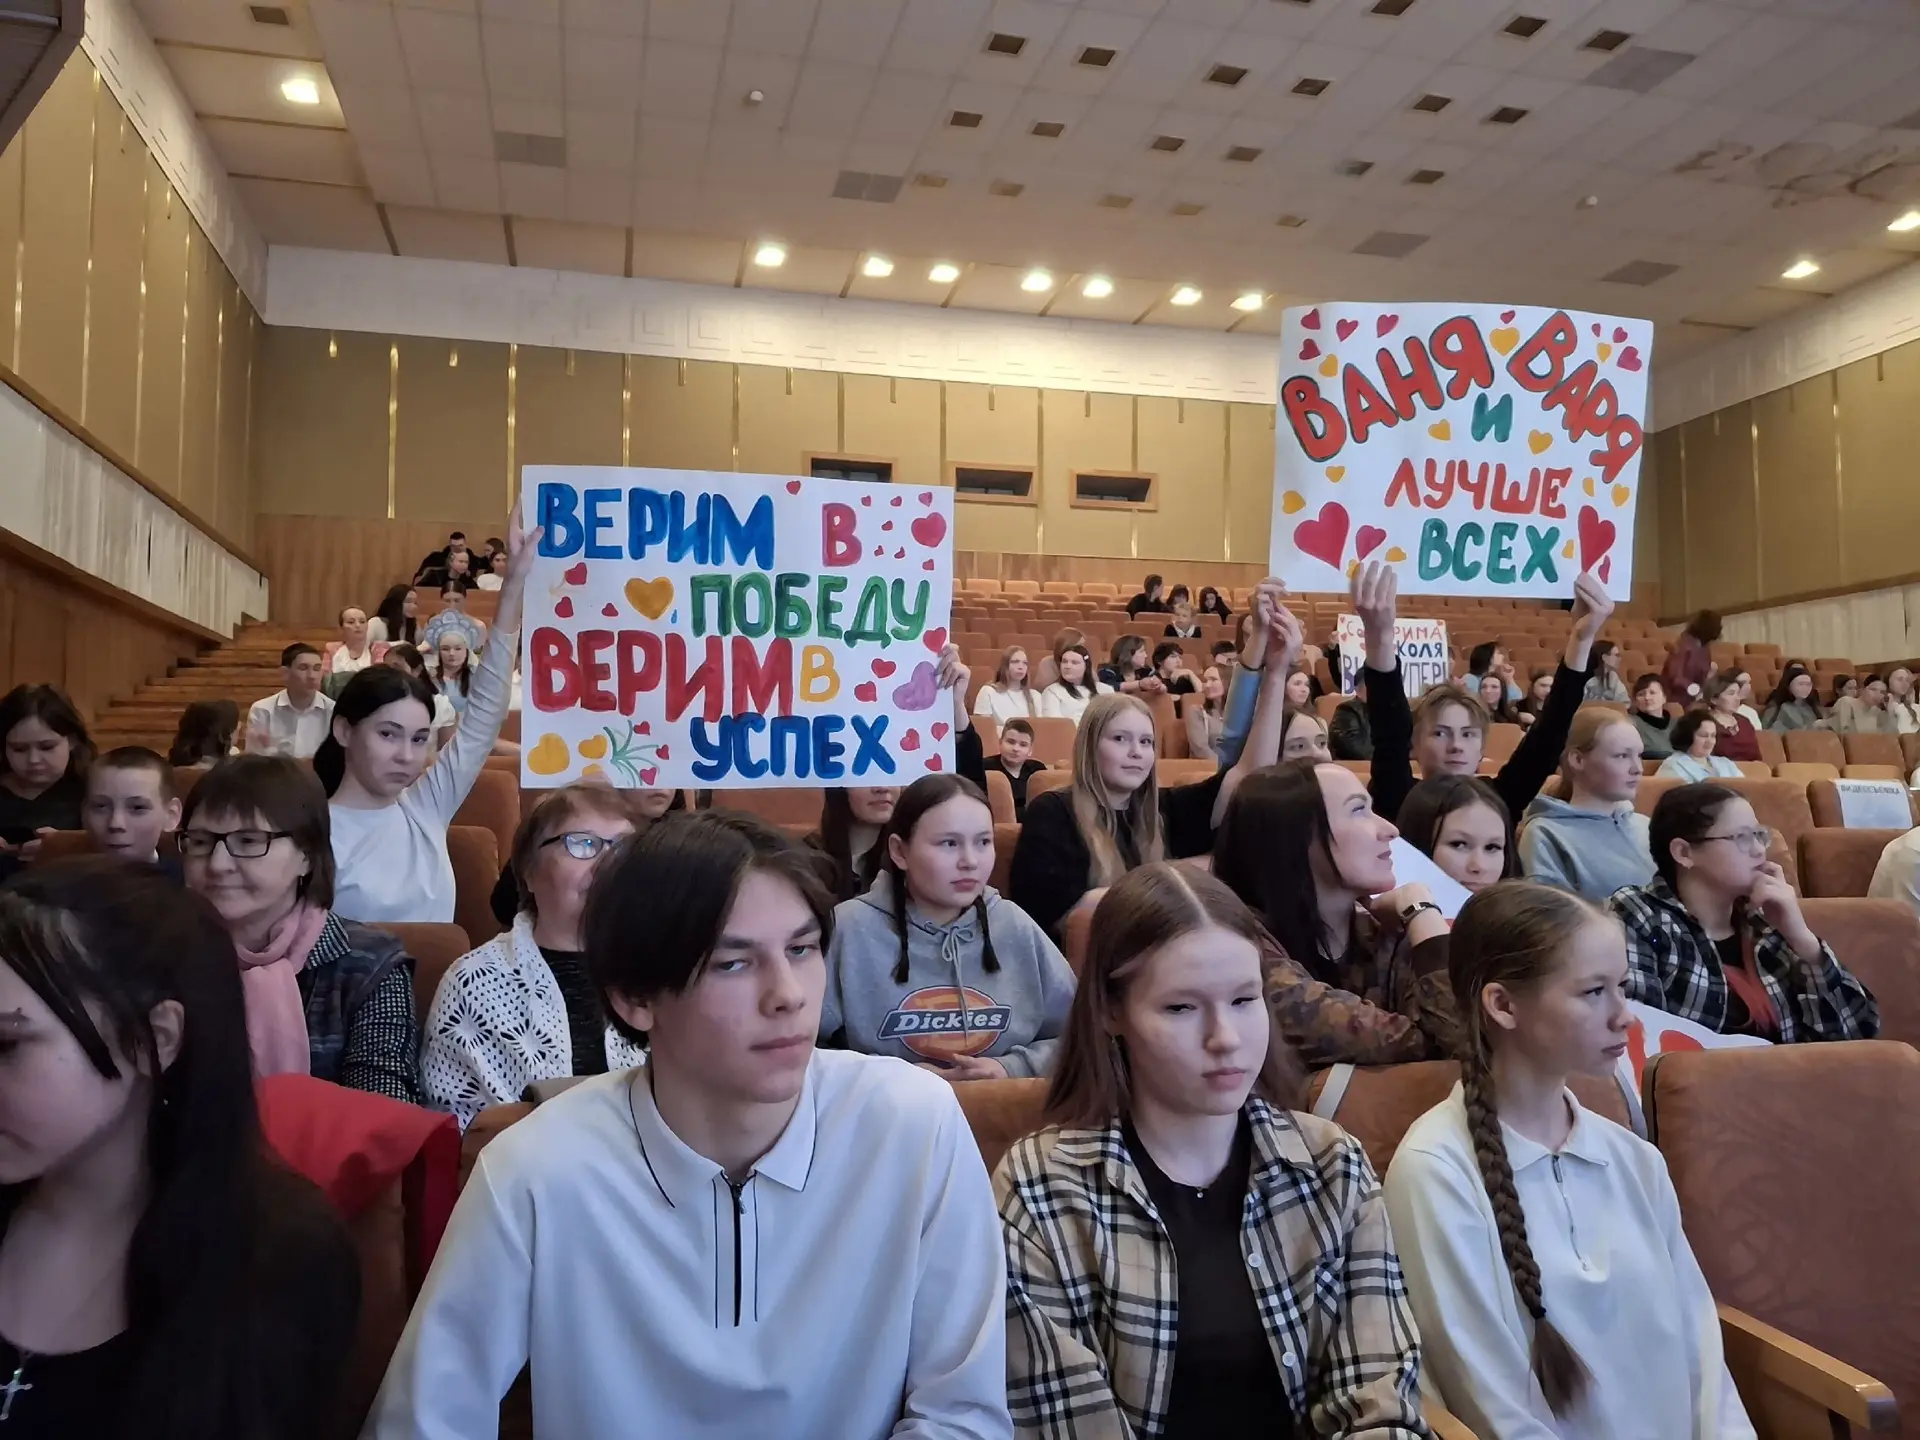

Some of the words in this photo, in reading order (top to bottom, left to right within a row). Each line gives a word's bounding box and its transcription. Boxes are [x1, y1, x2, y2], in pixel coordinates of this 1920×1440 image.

[1281, 315, 1495, 462] ВАНЯ
[1471, 392, 1513, 443] И
[1506, 310, 1644, 484] ВАРЯ
[1384, 457, 1573, 519] ЛУЧШЕ
[537, 482, 775, 570] ВЕРИМ
[822, 502, 863, 567] В
[1418, 517, 1560, 584] ВСЕХ
[690, 571, 931, 648] ПОБЕДУ
[530, 626, 793, 722] ВЕРИМ
[801, 645, 841, 702] В
[1397, 640, 1443, 658] КОЛЯ
[690, 712, 897, 781] УСПЕХ
[893, 1011, 1003, 1032] Dickies
